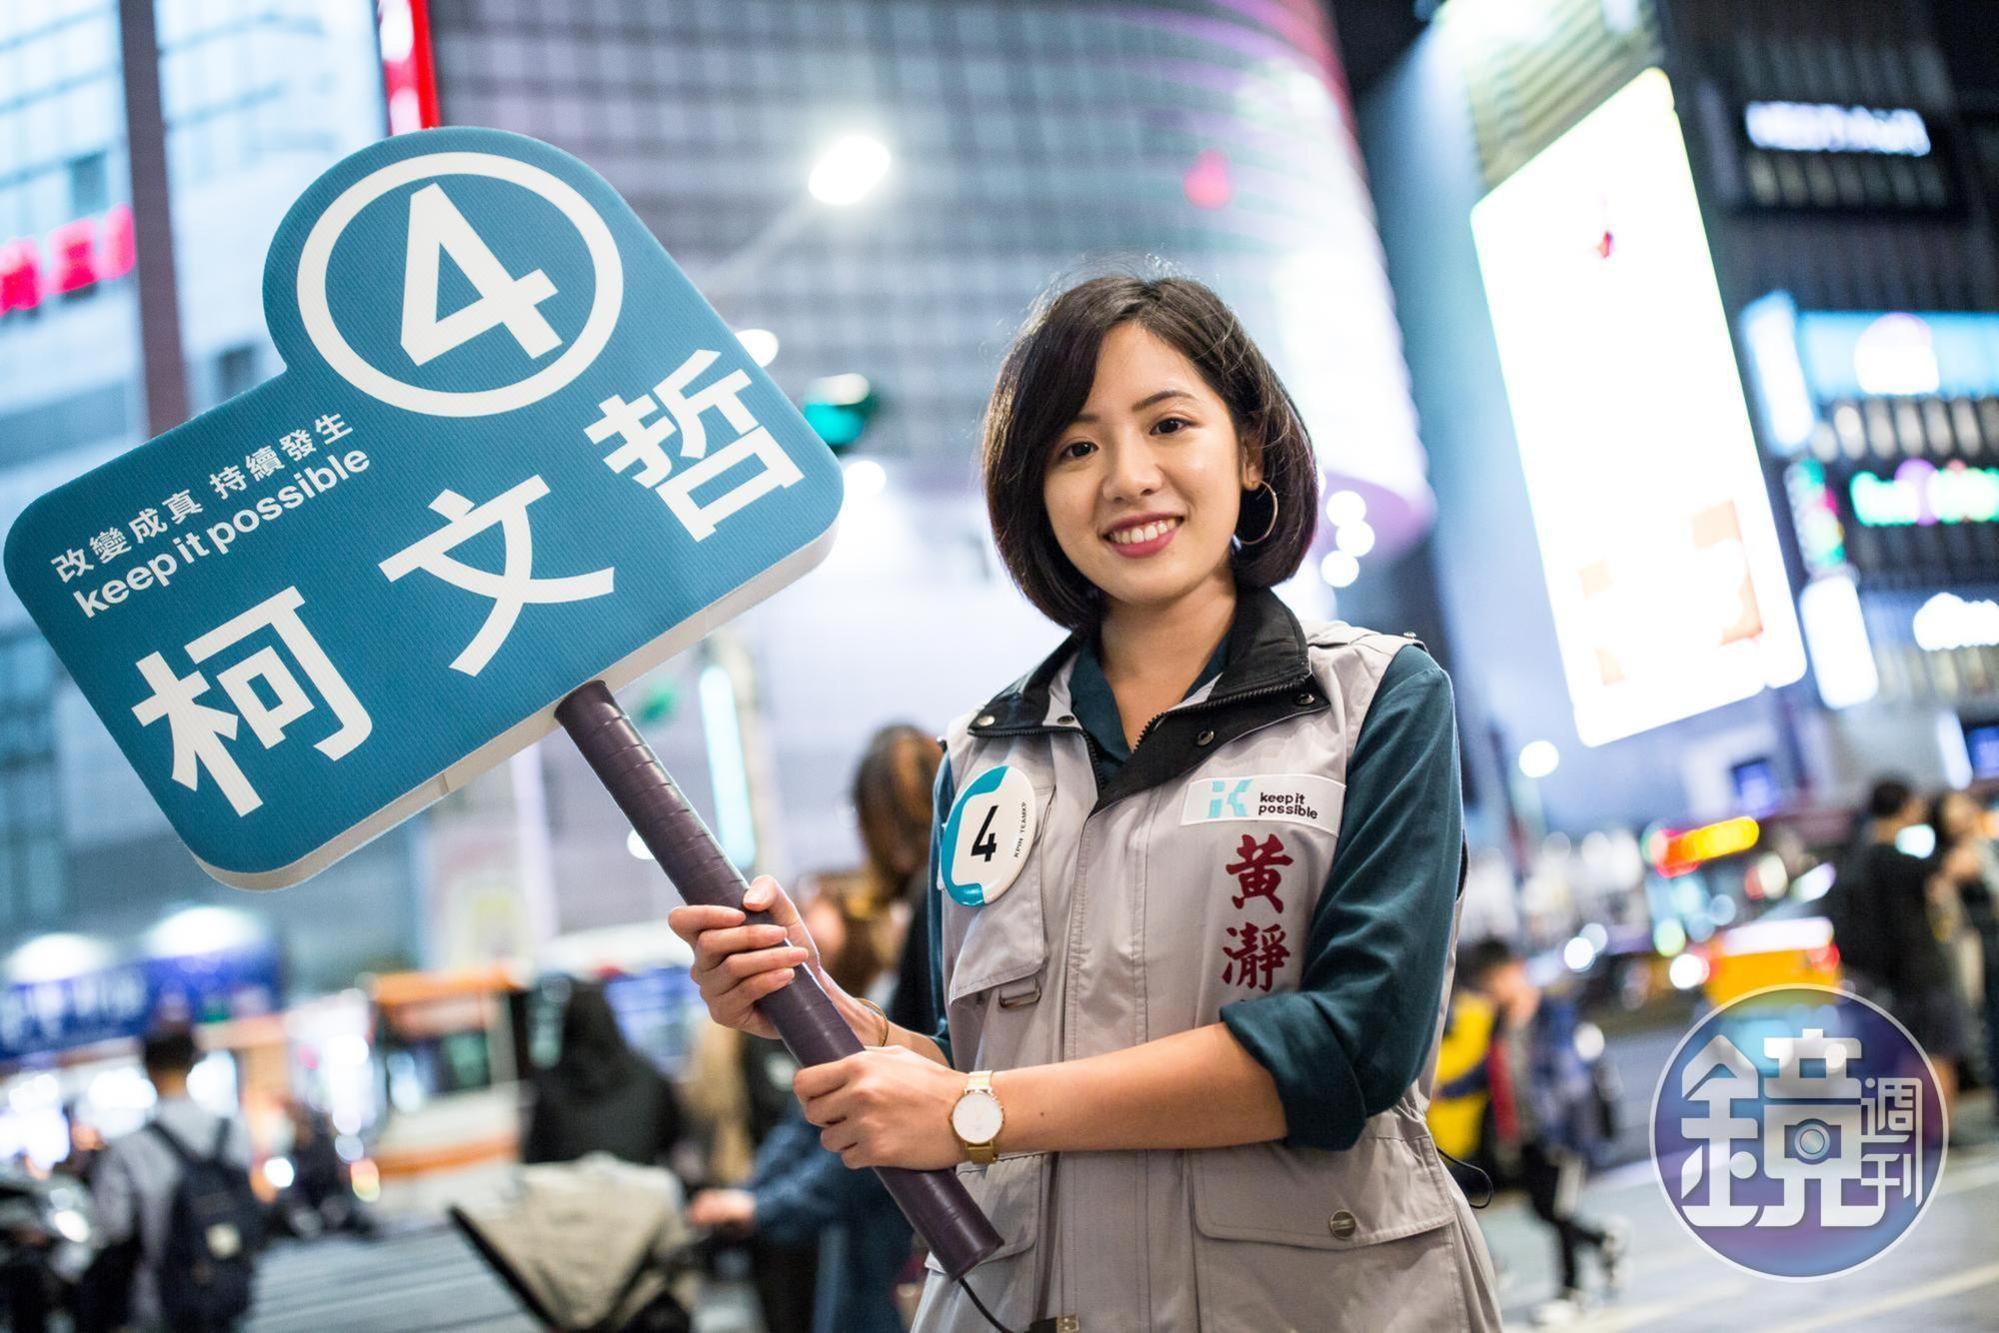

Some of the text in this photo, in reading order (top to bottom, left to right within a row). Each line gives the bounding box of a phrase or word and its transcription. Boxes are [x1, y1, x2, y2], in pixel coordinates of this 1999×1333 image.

[401, 183, 562, 367] 4
[50, 412, 353, 584] 改變成真 持續發生
[72, 449, 370, 619] keep it possible
[131, 348, 807, 818] 柯文哲
[970, 804, 999, 863] 4
[1257, 803, 1319, 820] possible
[1259, 791, 1306, 806] keep it
